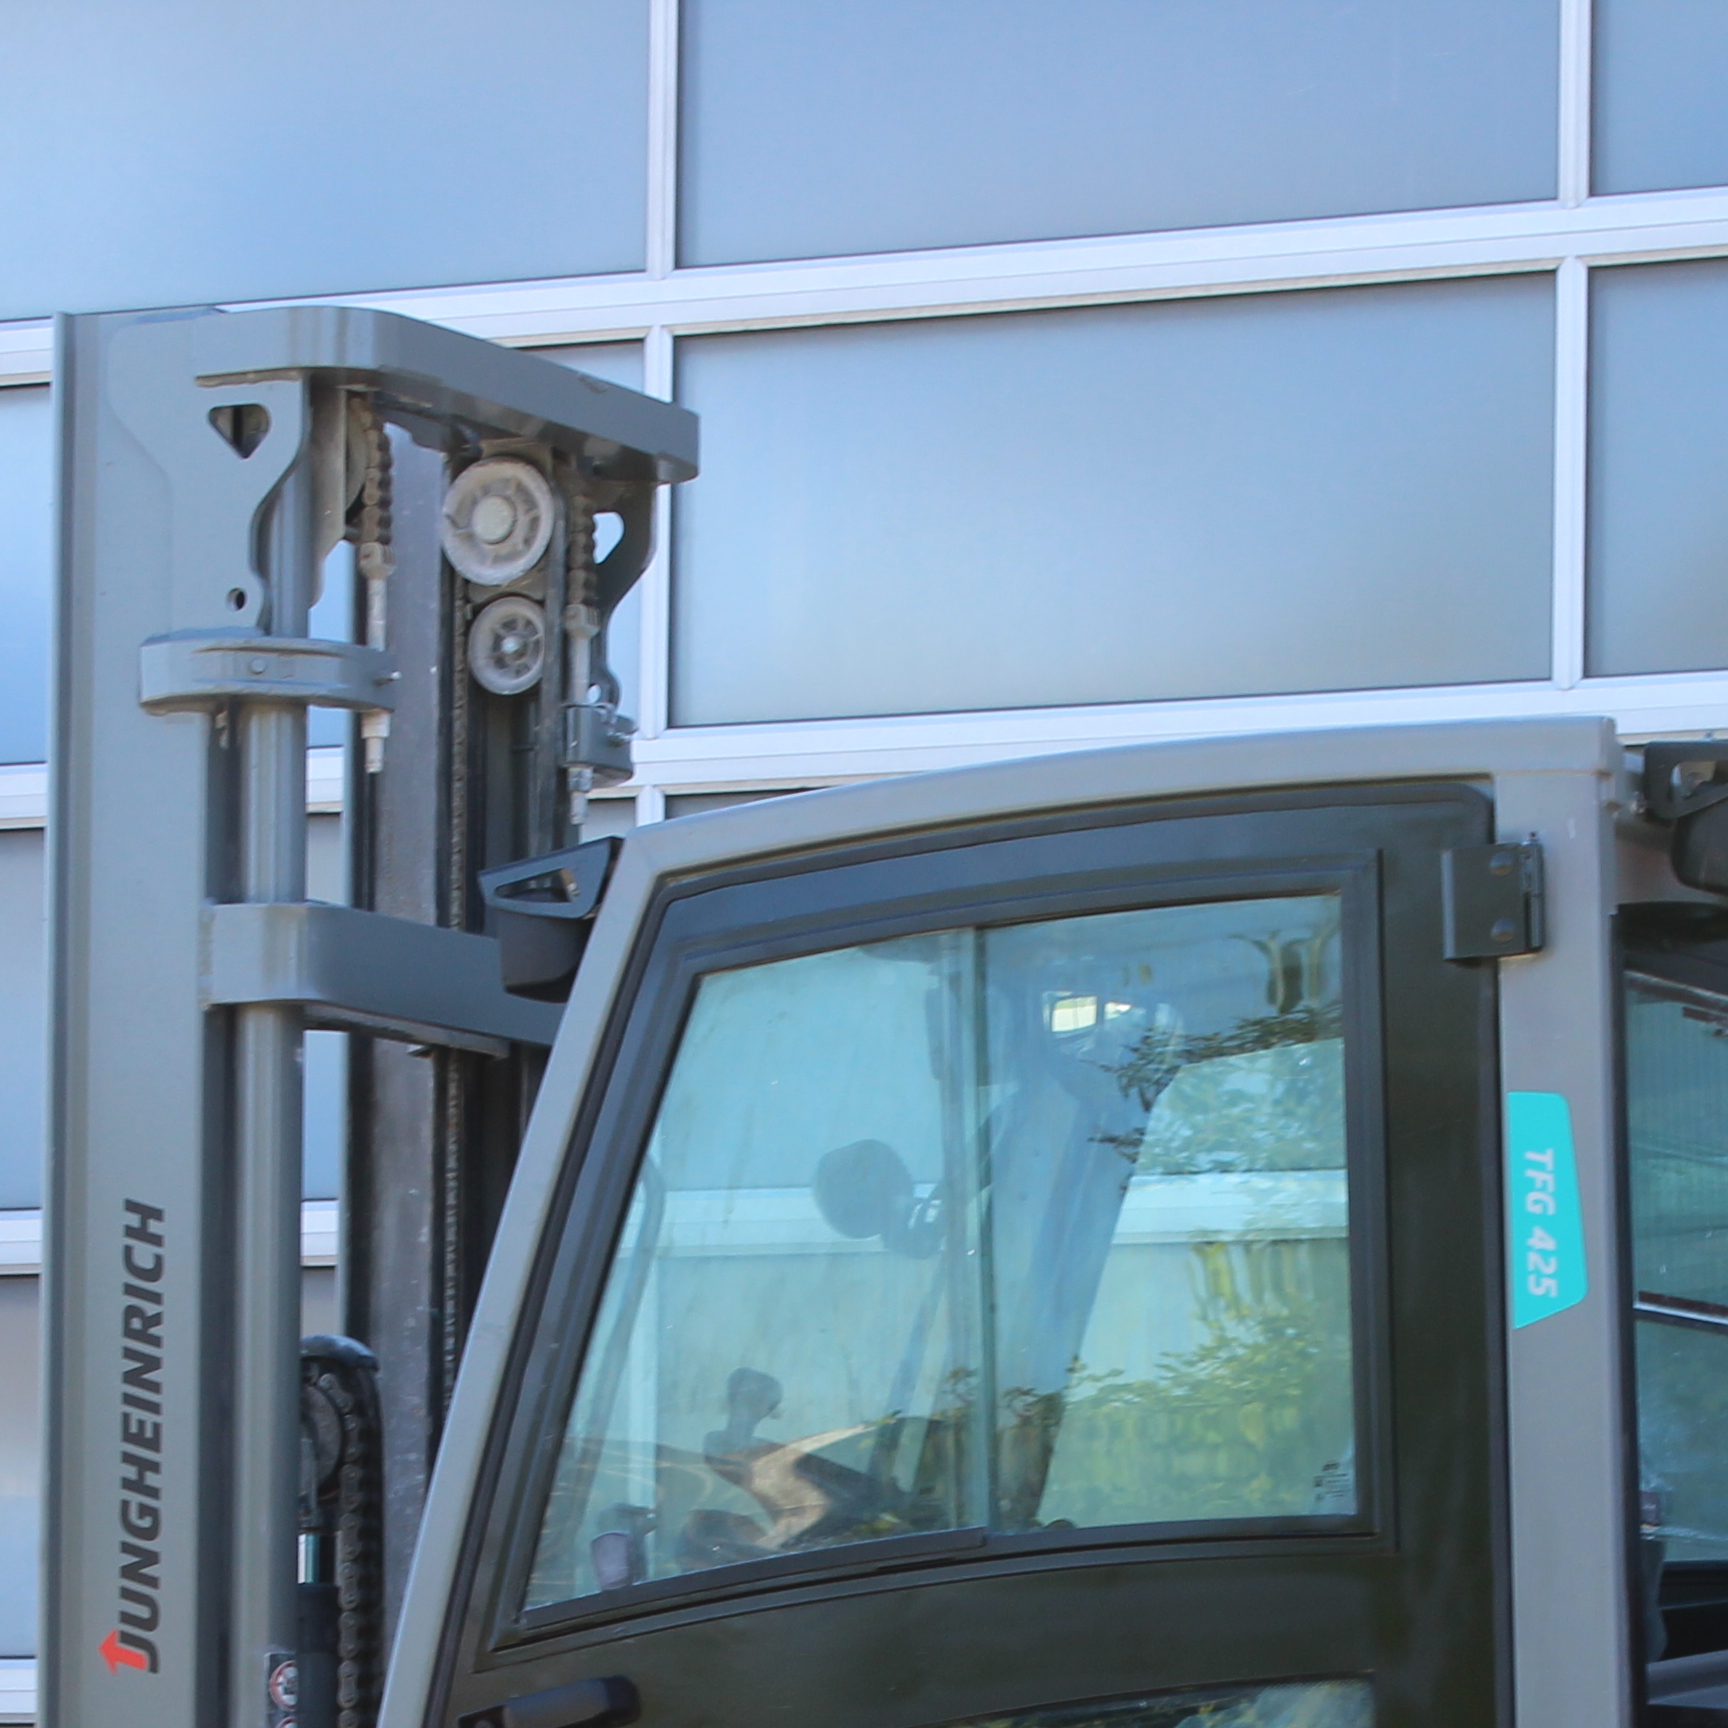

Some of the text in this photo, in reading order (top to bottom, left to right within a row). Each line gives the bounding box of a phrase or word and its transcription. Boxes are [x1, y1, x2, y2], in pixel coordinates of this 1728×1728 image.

[1524, 1148, 1559, 1298] TFG 425
[117, 1198, 165, 1675] JUNGHEINRICH
